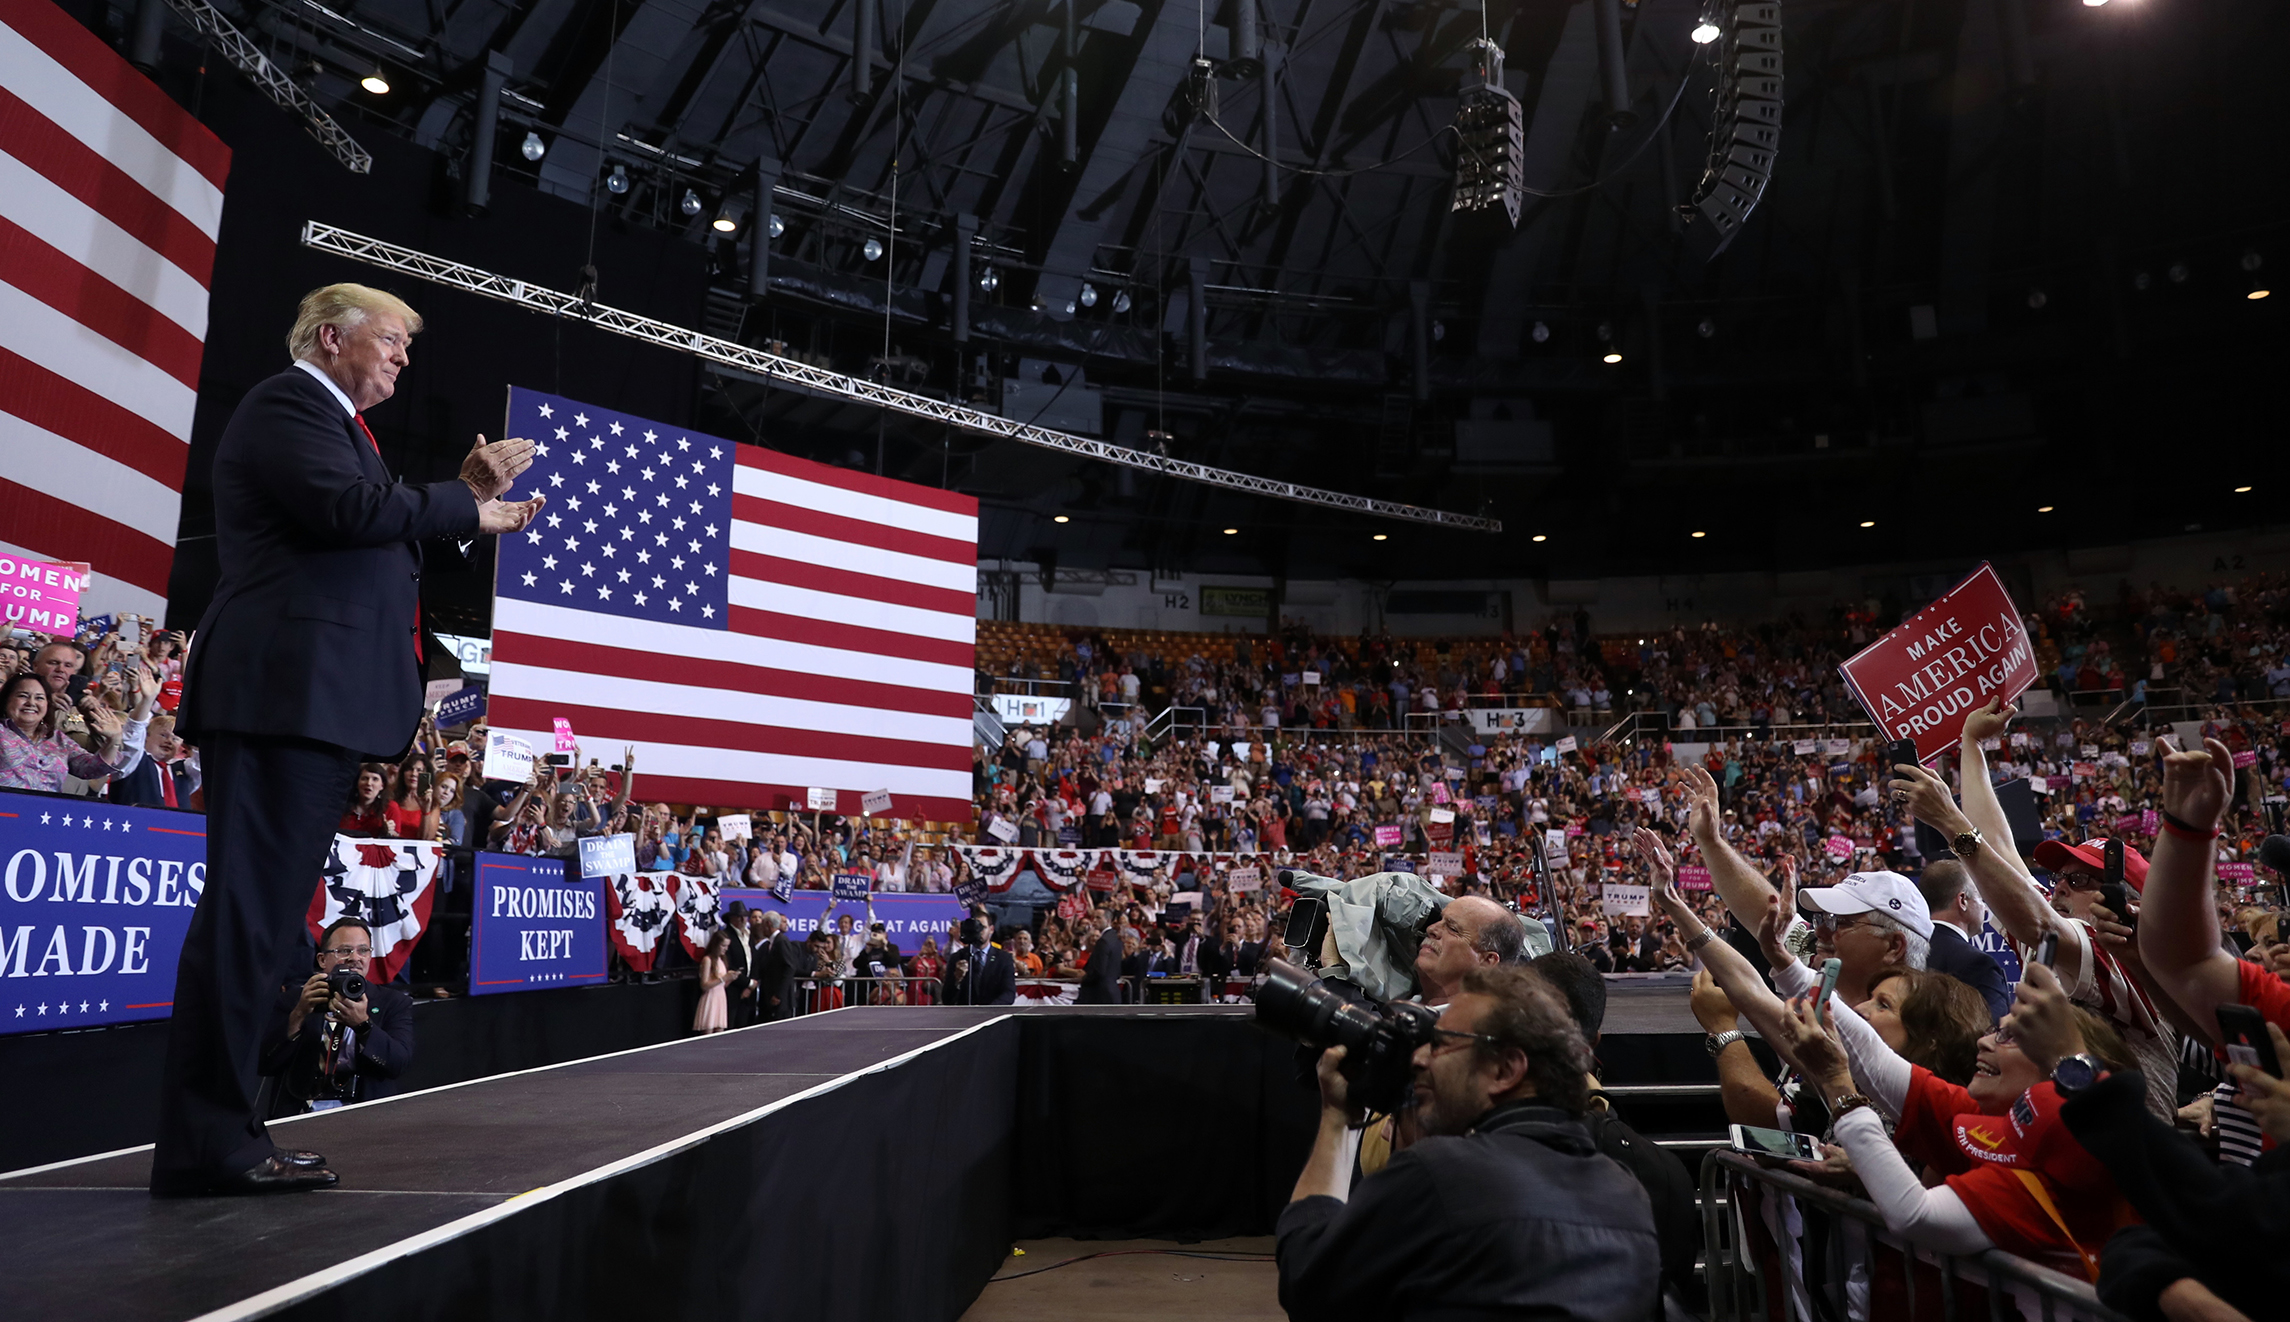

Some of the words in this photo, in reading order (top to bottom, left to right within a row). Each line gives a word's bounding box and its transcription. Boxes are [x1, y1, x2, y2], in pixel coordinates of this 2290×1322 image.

[0, 583, 42, 601] FOR
[1225, 593, 1268, 602] LYNCH
[1906, 617, 1962, 661] MAKE
[1880, 612, 2021, 723] AMERICA
[1896, 686, 1974, 738] PROUD
[1976, 642, 2027, 696] AGAIN
[501, 749, 532, 762] TRUMP
[1375, 826, 1400, 834] WOMEN
[586, 839, 627, 852] DRAIN
[1826, 845, 1850, 857] TRUMP
[600, 851, 615, 859] THE
[585, 858, 631, 872] SWAMP
[838, 876, 867, 885] DRAIN
[958, 880, 985, 895] DRAIN
[835, 889, 868, 898] SWAMP
[491, 885, 596, 920] PROMISES
[0, 924, 150, 978] MADE
[519, 929, 574, 961] KEPT
[1965, 1143, 2017, 1163] PRESIDENT
